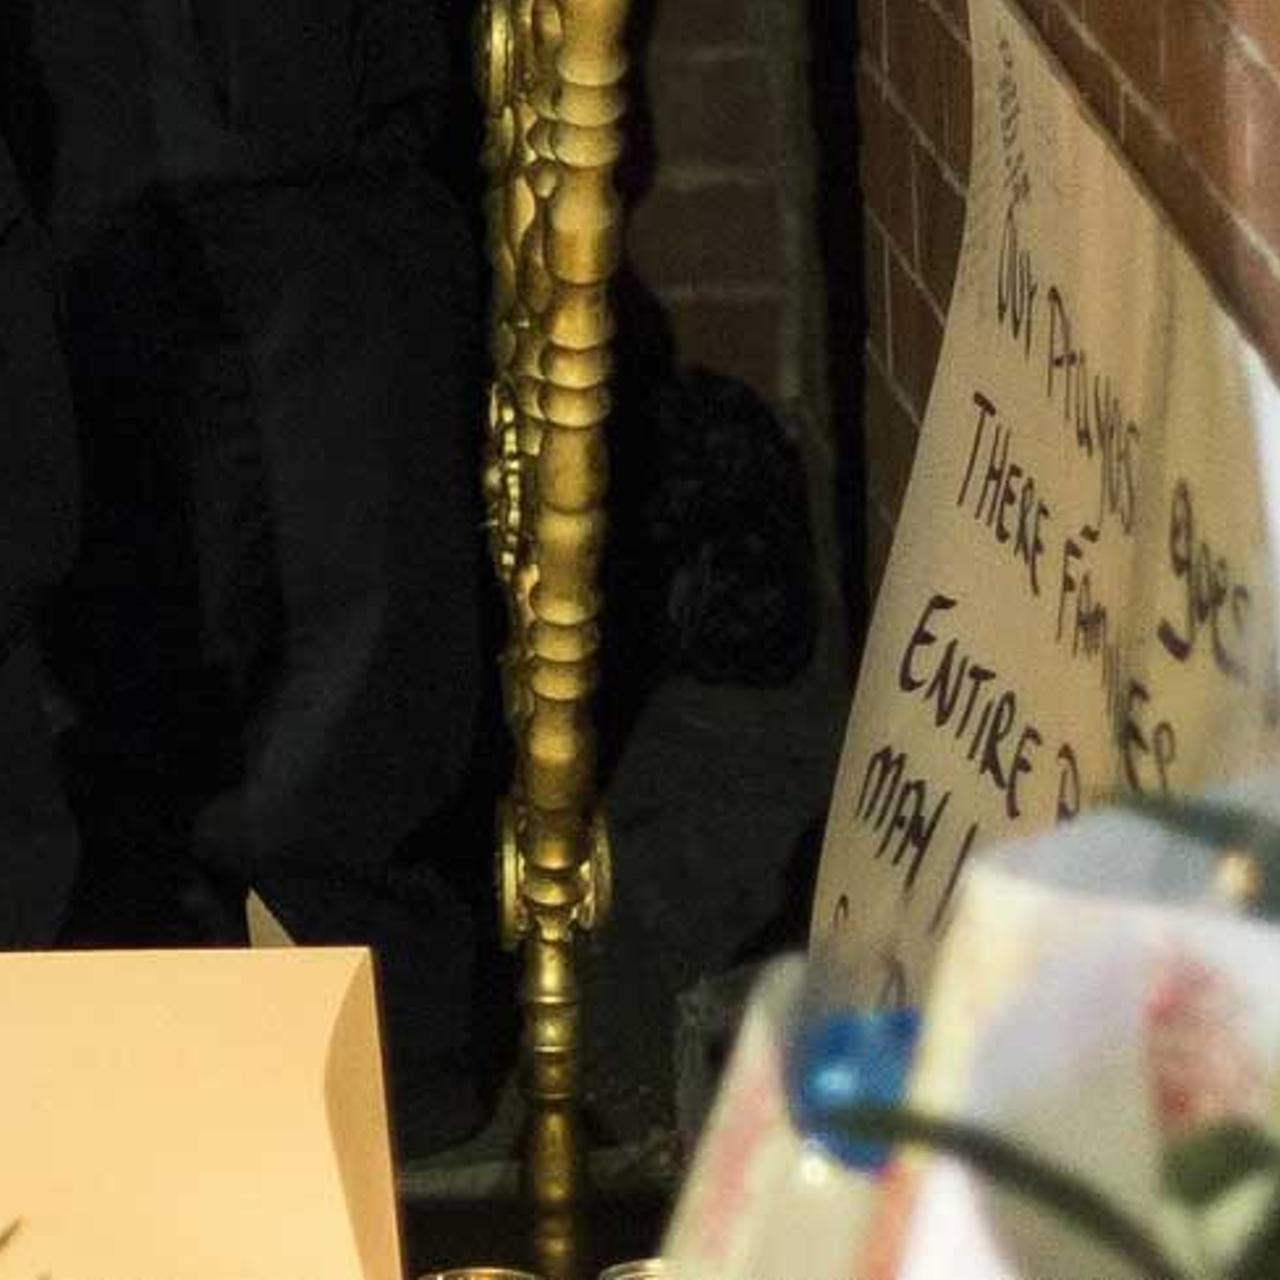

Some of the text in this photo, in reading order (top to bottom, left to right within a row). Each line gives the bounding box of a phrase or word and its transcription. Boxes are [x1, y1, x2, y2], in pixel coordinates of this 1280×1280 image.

[957, 391, 1049, 595] THERE
[899, 594, 1043, 819] ENTIRE
[856, 745, 951, 896] MAY
